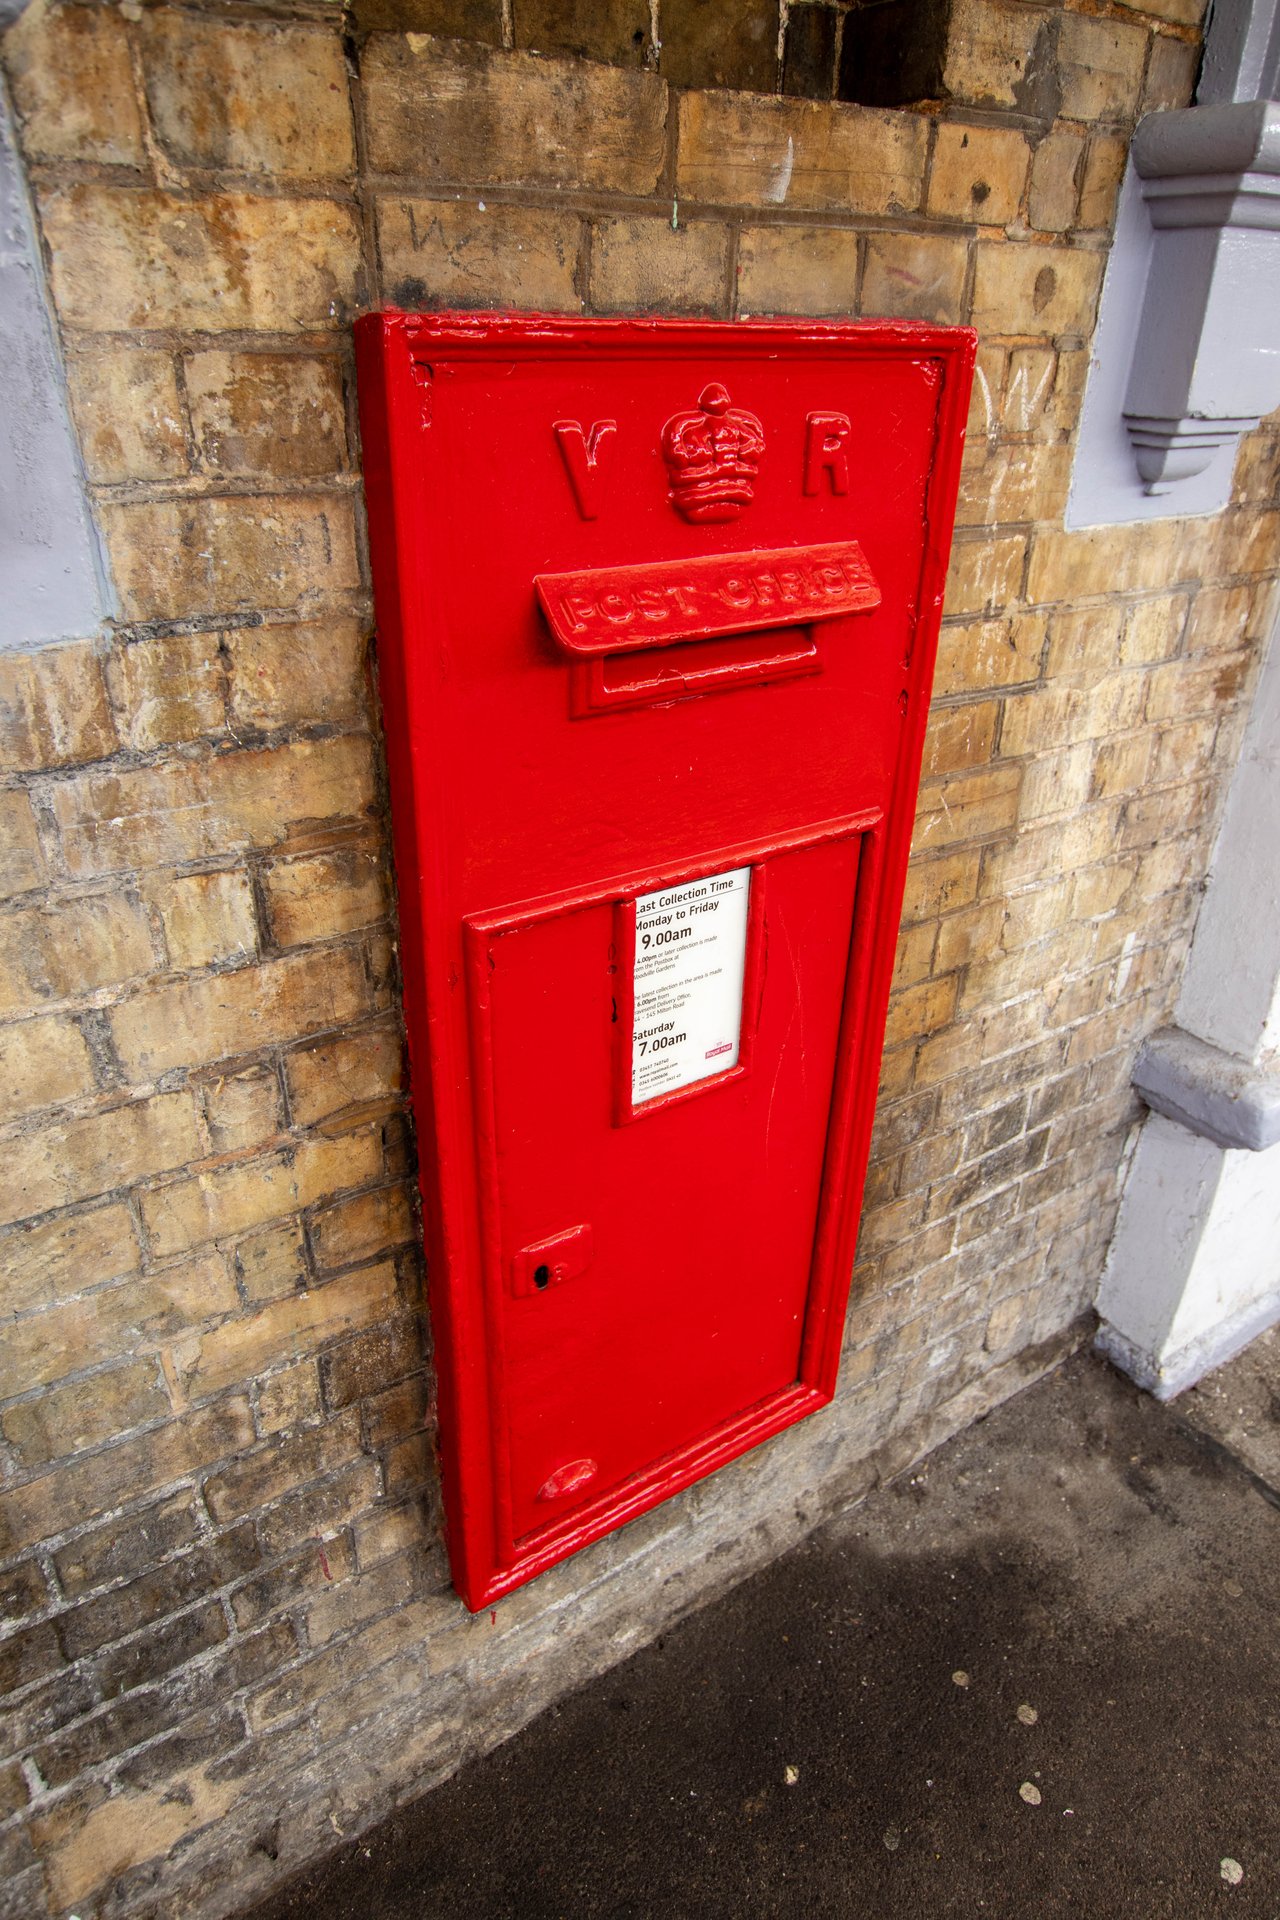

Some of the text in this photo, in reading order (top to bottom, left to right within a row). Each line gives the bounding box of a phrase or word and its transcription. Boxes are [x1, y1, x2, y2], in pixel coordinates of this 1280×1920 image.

[552, 410, 851, 521] V R
[559, 562, 871, 632] POST OFFICE
[659, 886, 707, 908] Collection
[709, 879, 734, 893] Time
[676, 911, 686, 920] to
[689, 900, 720, 916] Friday
[641, 927, 692, 950] 9.00am
[637, 954, 657, 964] 4.00pm
[664, 948, 676, 956] later
[676, 941, 699, 952] collection
[704, 935, 717, 943] made
[654, 957, 673, 967] Postbox
[656, 963, 676, 974] Gardens
[642, 990, 655, 999] latest
[656, 982, 678, 994] collection
[709, 968, 723, 976] made
[634, 1003, 656, 1015] ravesend
[657, 997, 676, 1008] Delivery
[637, 997, 657, 1007] 6.00pm
[657, 1006, 672, 1015] Milton
[673, 1001, 685, 1010] Road
[633, 1021, 675, 1041] Saturday
[638, 1032, 687, 1057] 7.00am
